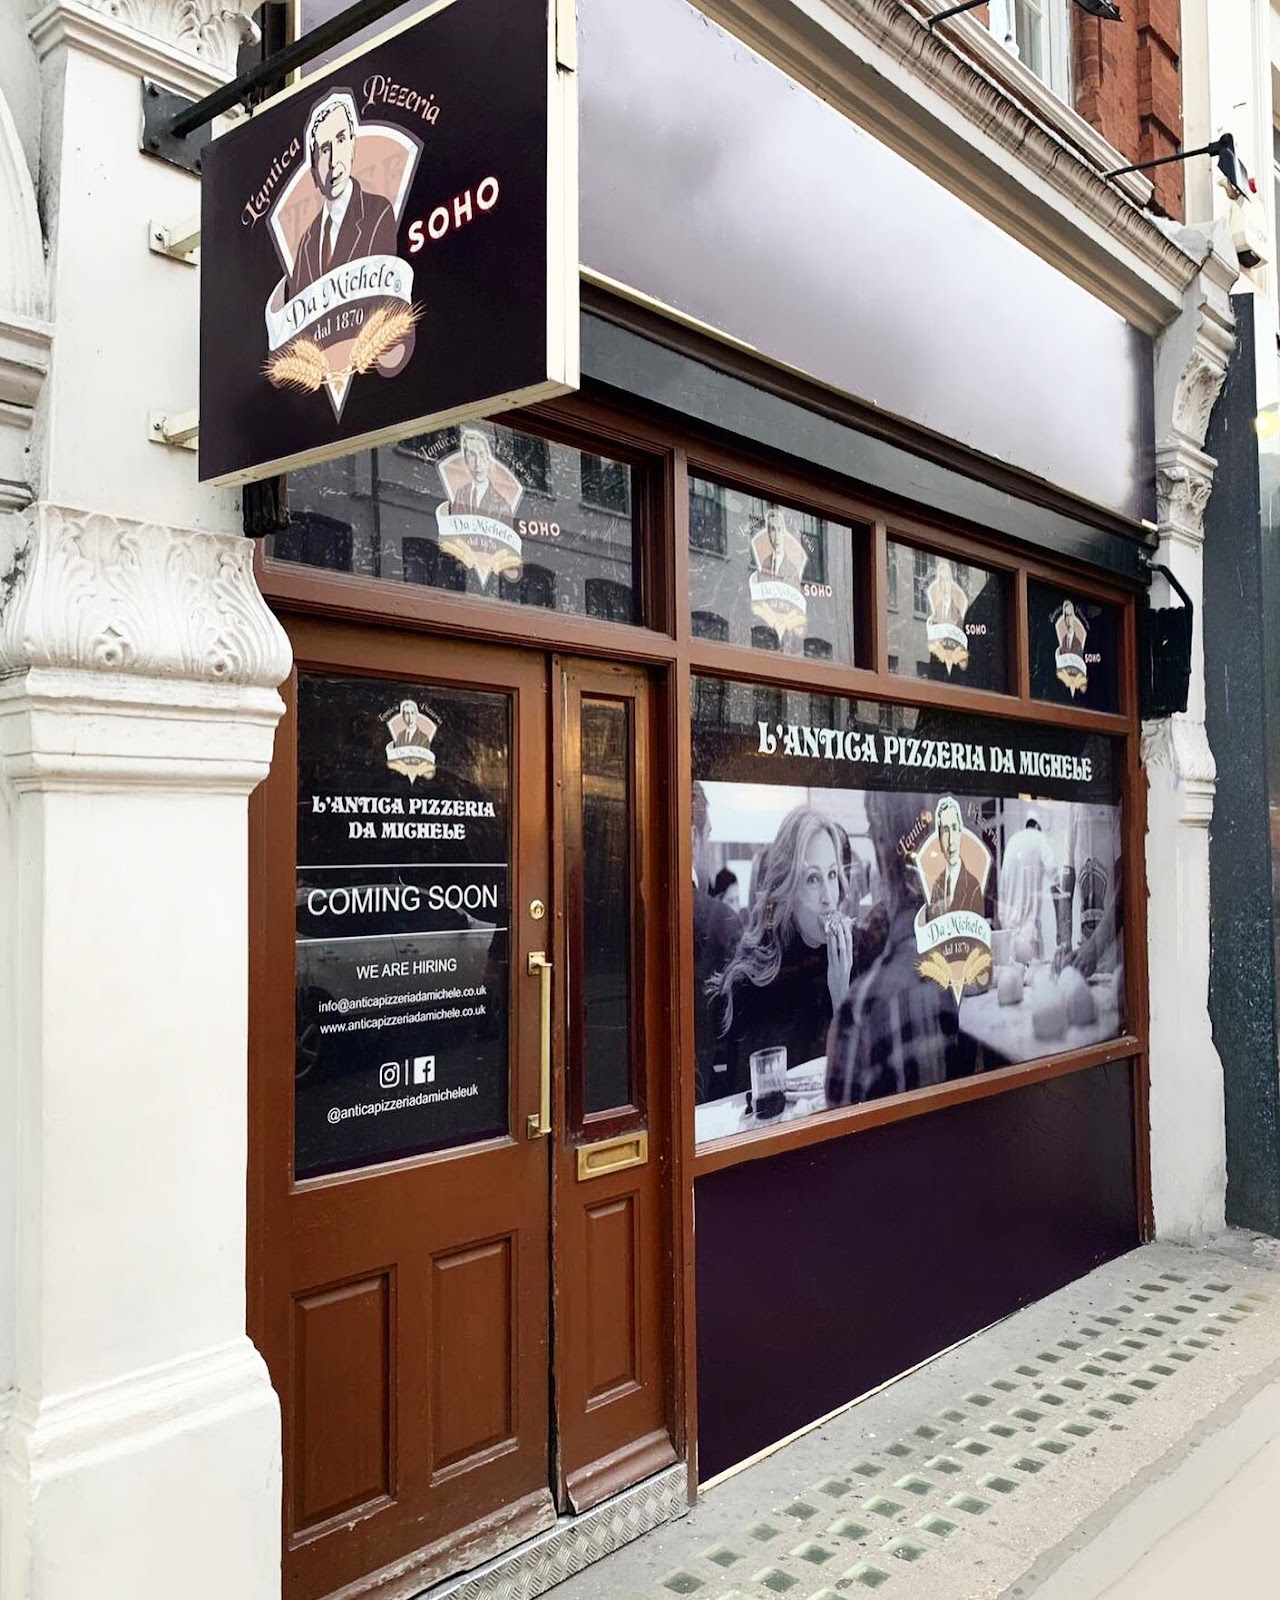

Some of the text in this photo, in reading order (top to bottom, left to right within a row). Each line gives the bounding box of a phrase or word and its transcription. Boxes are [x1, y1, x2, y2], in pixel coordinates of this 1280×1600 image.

[362, 75, 440, 125] Pizzeria
[408, 176, 500, 252] SOHO
[286, 264, 394, 330] Da Michele
[314, 308, 364, 341] dal 1870
[518, 519, 561, 536] SOHO
[804, 584, 833, 597] SOHO
[965, 624, 987, 636] SOHO
[1084, 653, 1102, 664] SOHO
[757, 721, 1093, 782] L'ANTICA PIZZERIA DA MICHELE
[312, 796, 496, 818] L'ANTICA PIZZERIA
[349, 822, 466, 840] DA MICHELE
[307, 884, 498, 916] COMING SOON
[356, 958, 457, 979] WE ARE HIRING
[318, 985, 487, 1013] info@anticapizzeriadamichele.co.uk
[320, 1005, 486, 1034] www.anticapizzeriadamichele.co.uk
[327, 1084, 478, 1124] @anticapizzeriadamicheleuk
